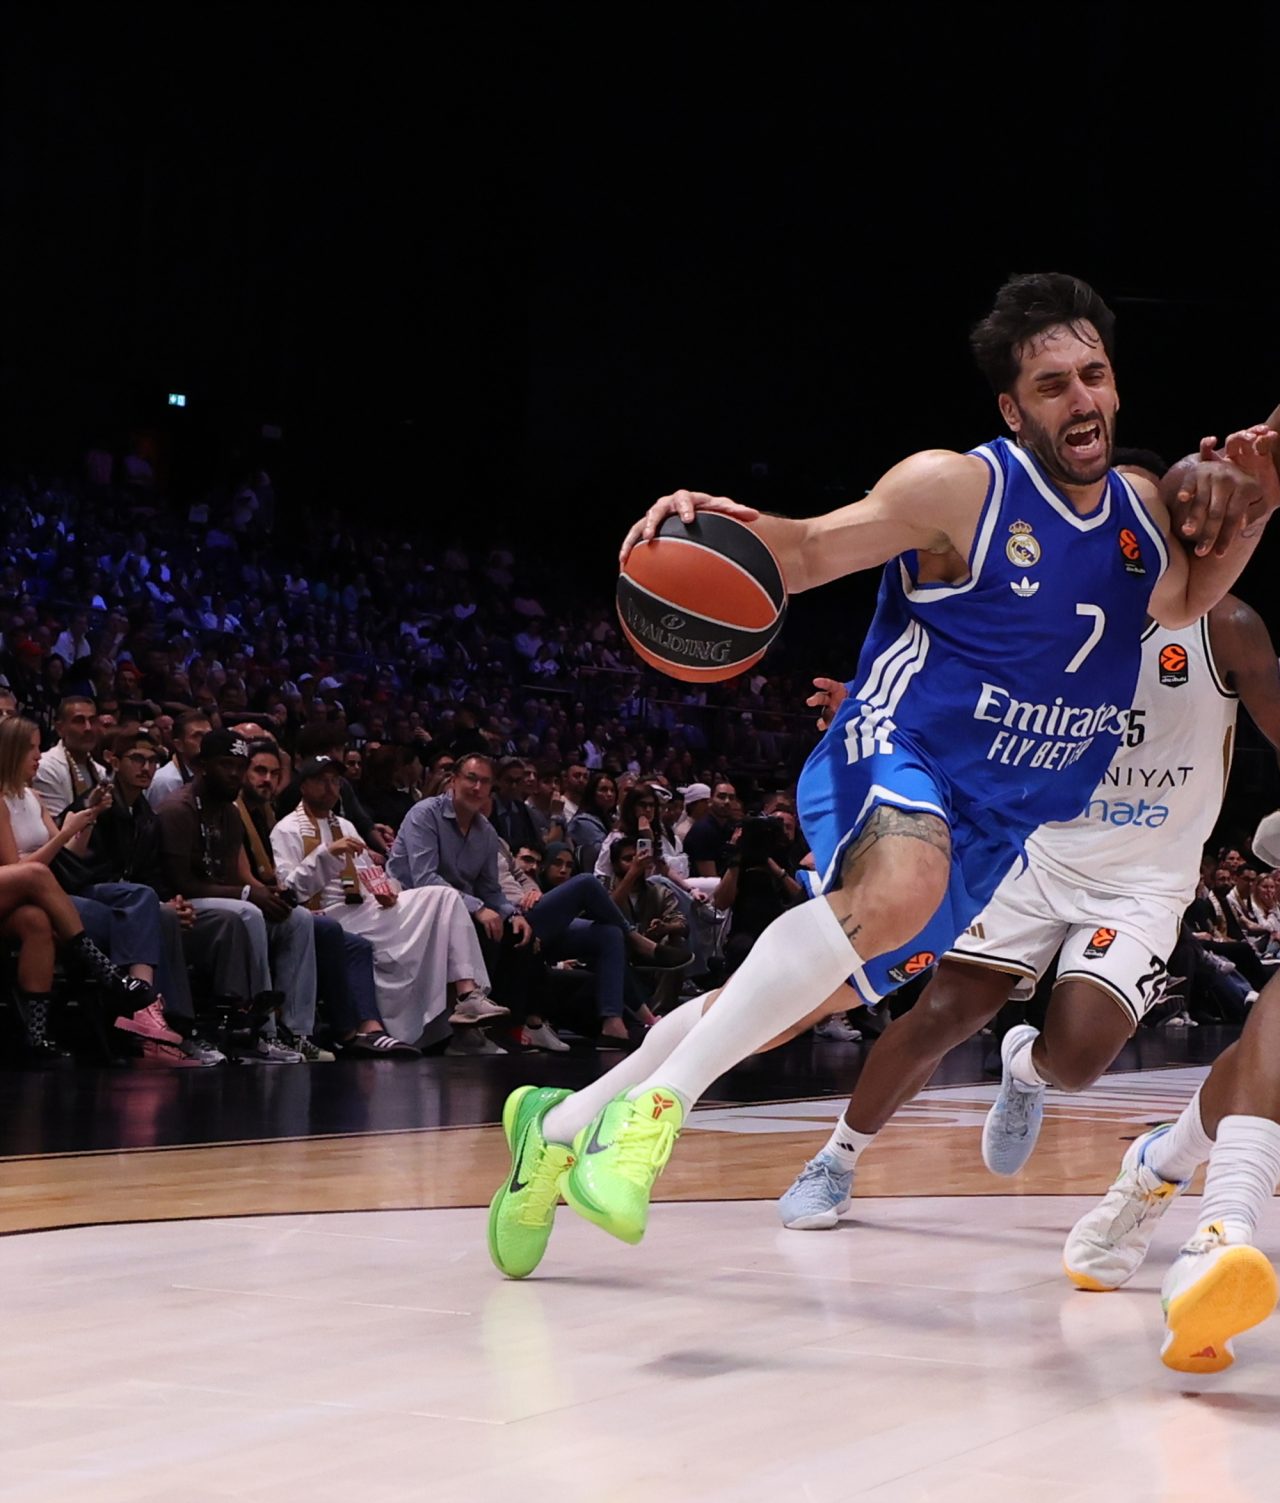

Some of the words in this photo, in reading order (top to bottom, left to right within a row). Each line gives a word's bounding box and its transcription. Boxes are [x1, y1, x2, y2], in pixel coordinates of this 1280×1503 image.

[1064, 603, 1106, 673] 7
[973, 682, 1131, 737] Emirates
[1119, 710, 1146, 748] 5
[986, 731, 1036, 767] FLY
